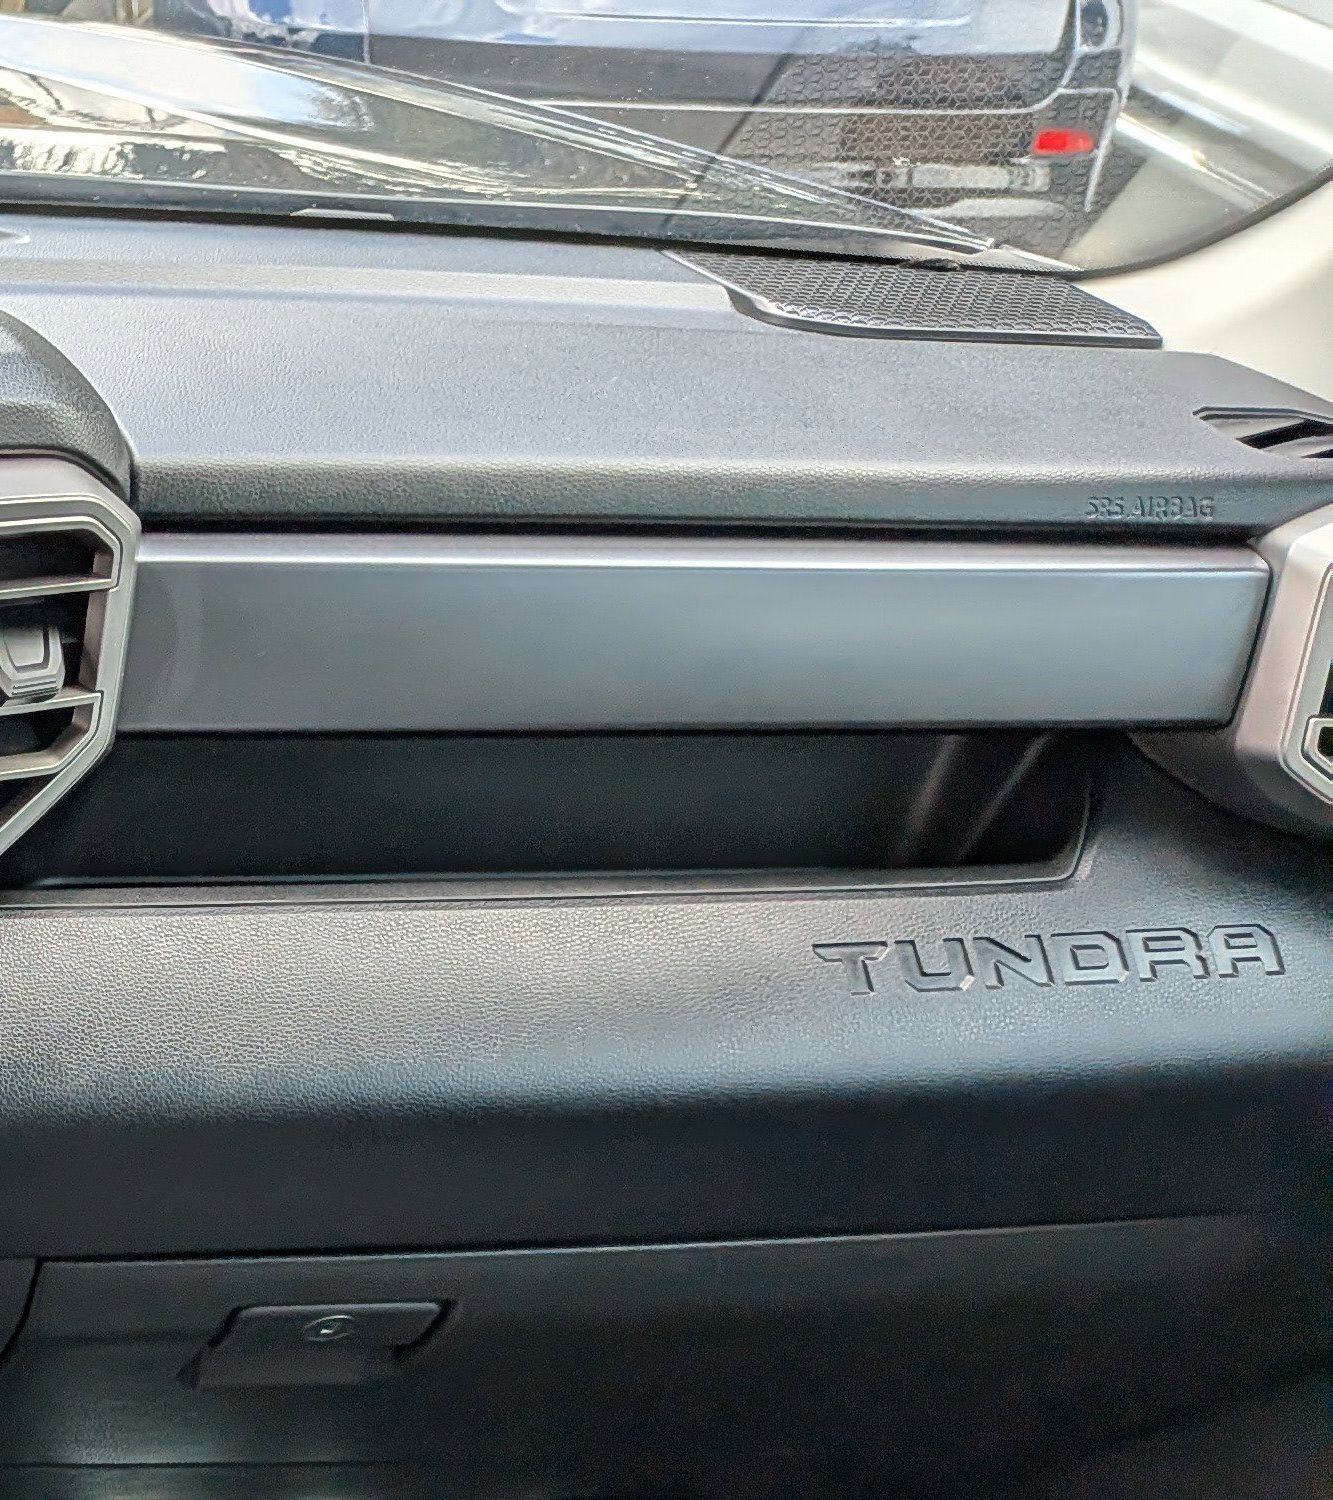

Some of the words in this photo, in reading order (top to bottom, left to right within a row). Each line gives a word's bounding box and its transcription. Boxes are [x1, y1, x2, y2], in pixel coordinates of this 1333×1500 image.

[1086, 496, 1125, 519] SRS
[1129, 496, 1215, 521] AIRBAG
[811, 923, 1286, 997] TUNDRA
